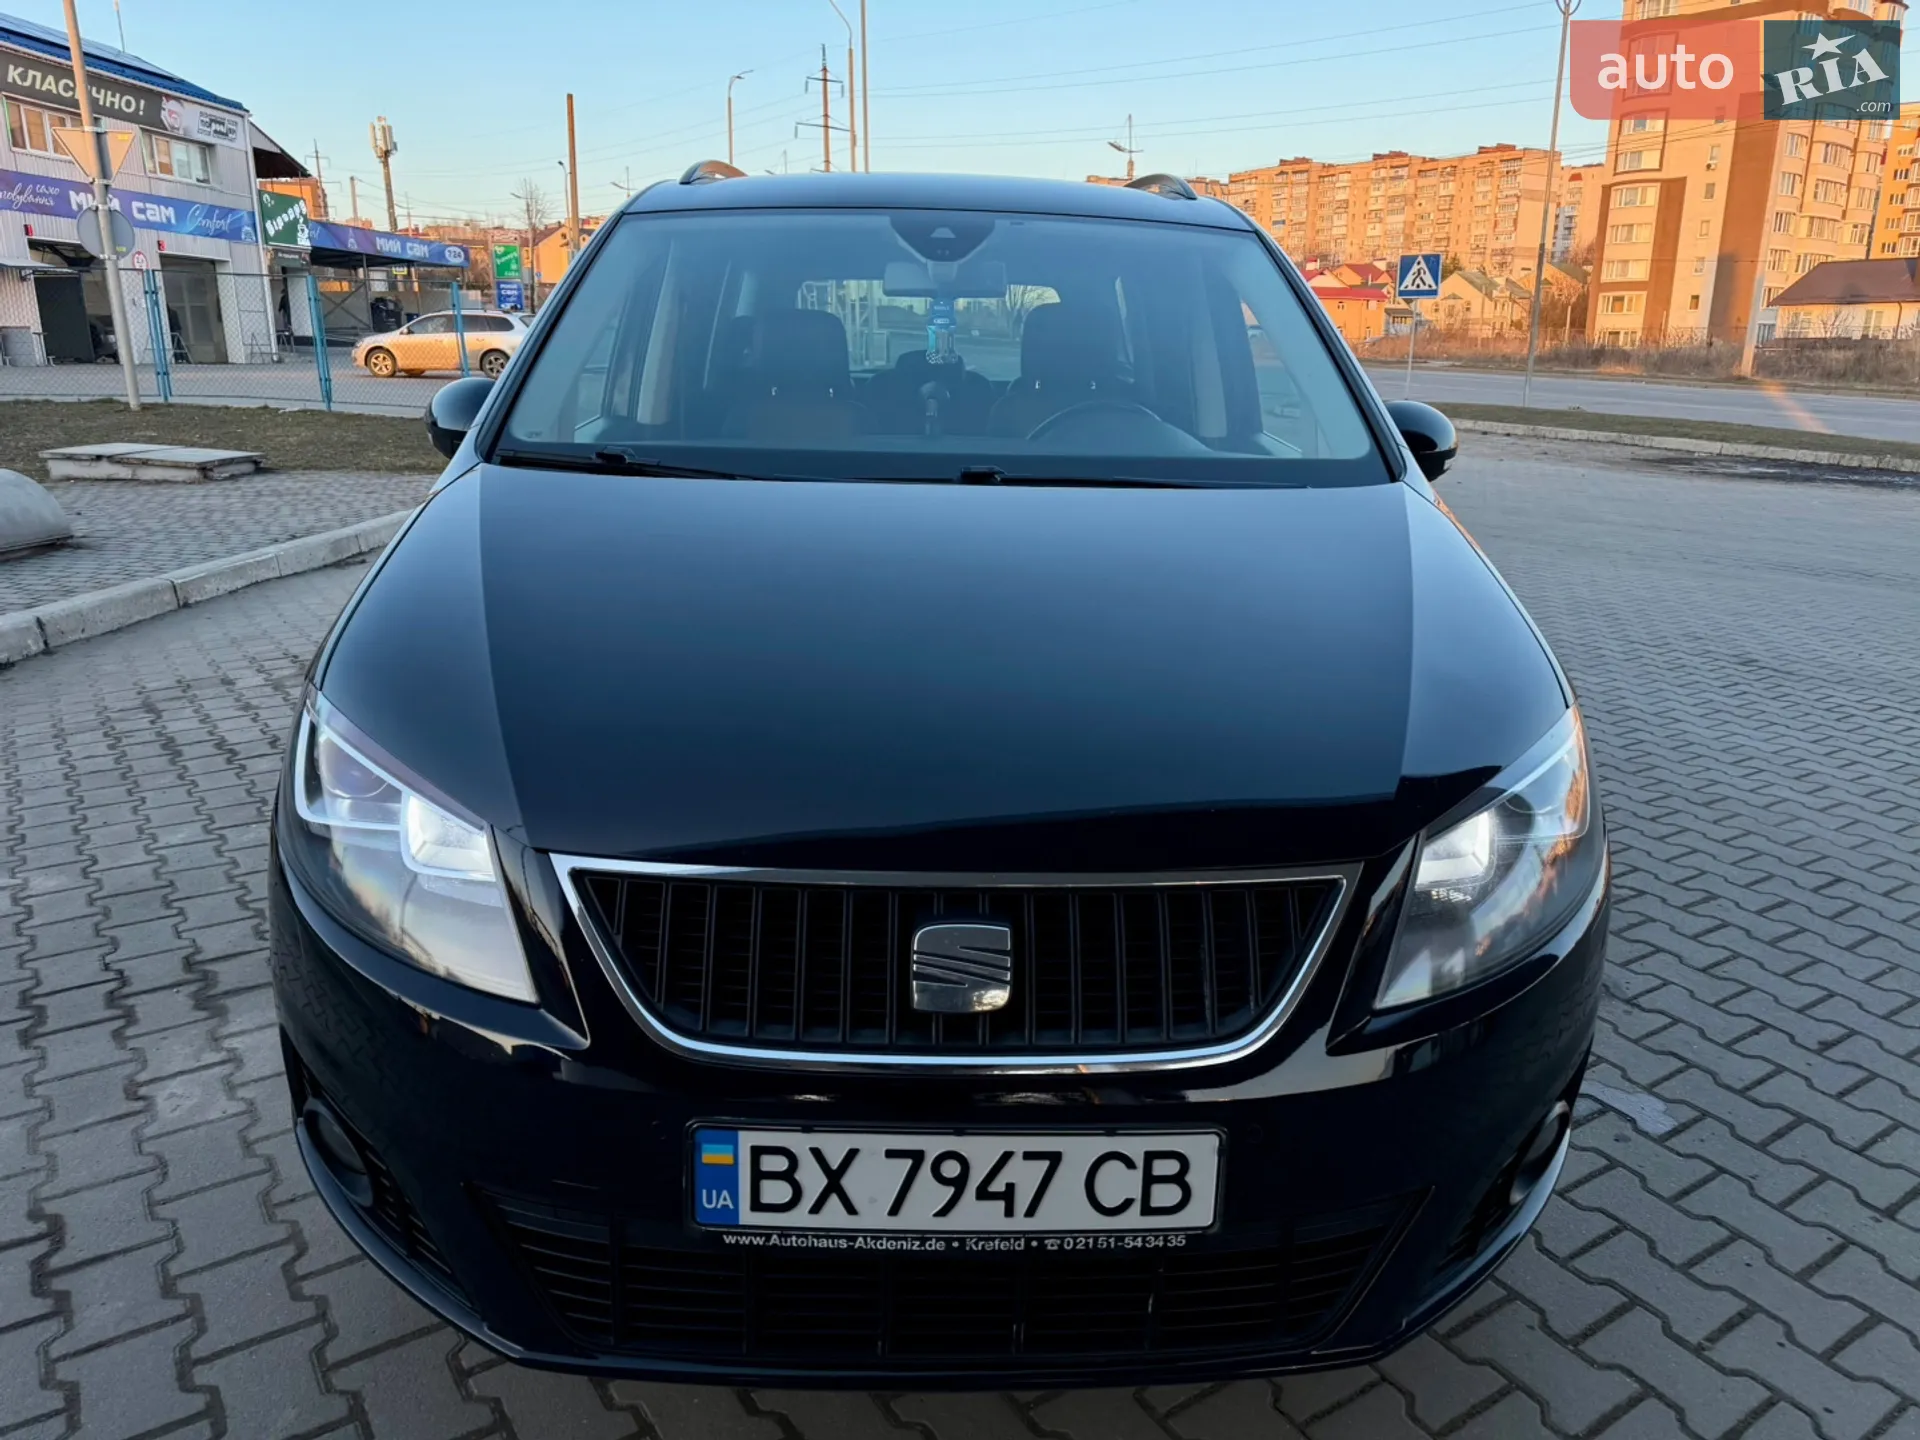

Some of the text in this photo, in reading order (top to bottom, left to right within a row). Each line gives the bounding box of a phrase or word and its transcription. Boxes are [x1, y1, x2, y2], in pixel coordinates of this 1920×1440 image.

[750, 1145, 1192, 1219] BX 7947 CB
[702, 1189, 734, 1209] UA
[722, 1233, 946, 1250] www.Autohaus-Akdeniz.de
[965, 1237, 1025, 1251] Krefeld
